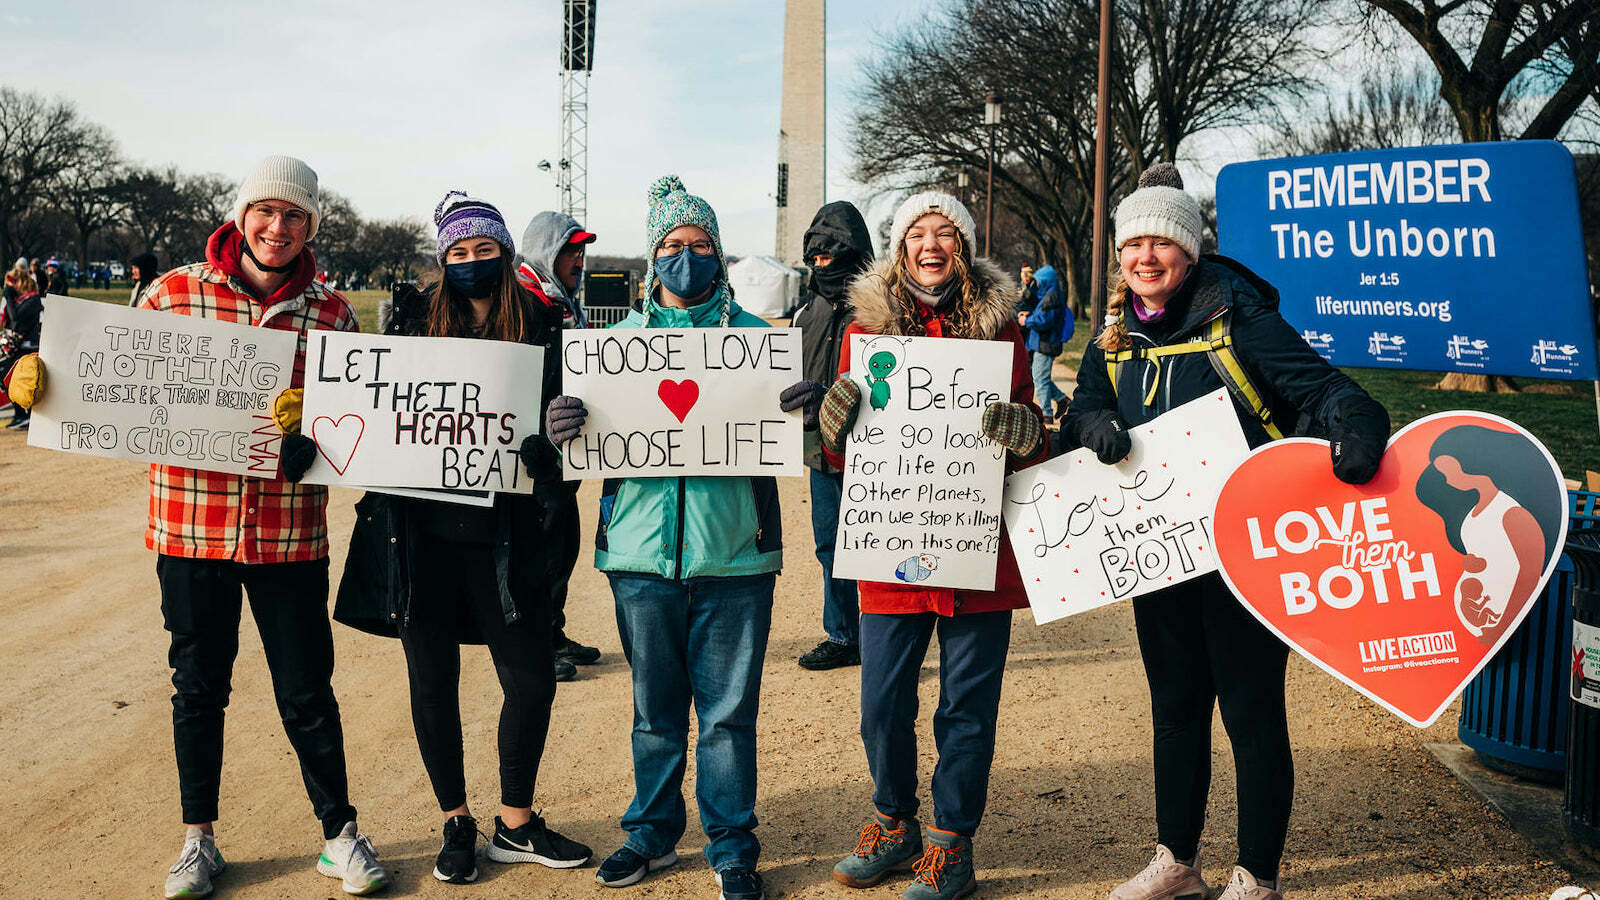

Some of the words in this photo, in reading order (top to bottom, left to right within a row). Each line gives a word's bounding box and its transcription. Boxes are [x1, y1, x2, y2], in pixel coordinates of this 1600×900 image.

[1267, 158, 1492, 211] REMEMBER
[1270, 222, 1334, 259] The
[1348, 219, 1496, 258] Unborn
[1359, 272, 1377, 286] Jer
[1379, 272, 1400, 286] 1:5
[1315, 295, 1452, 322] liferunners.org
[105, 325, 212, 356] THERE
[230, 338, 257, 360] is
[318, 335, 392, 383] LET
[564, 334, 686, 375] CHOOSE
[703, 332, 792, 371] LOVE
[78, 351, 281, 390] NOTHING
[81, 383, 162, 405] EASIER
[163, 384, 210, 405] THAN
[215, 389, 269, 410] BEING
[365, 381, 482, 413] THEIR
[907, 366, 1000, 411] Before
[150, 405, 169, 425] A
[395, 412, 517, 446] HEARTS
[60, 421, 118, 450] PRO
[126, 426, 249, 463] CHOICE
[247, 415, 282, 472] MAN
[568, 429, 685, 470] CHOOSE
[702, 419, 786, 467] LIFE
[900, 423, 933, 449] go
[442, 446, 521, 489] BEAT
[849, 453, 888, 475] for
[897, 454, 935, 476] life
[947, 461, 975, 477] on
[848, 481, 911, 502] Other
[918, 483, 986, 504] Planets,
[844, 508, 883, 526] Can
[1010, 470, 1175, 558] Love
[1104, 514, 1167, 546] them
[1246, 497, 1393, 560] LOVE
[843, 530, 880, 550] Life
[920, 532, 953, 550] this
[1313, 531, 1416, 569] them
[1279, 552, 1442, 616] BOTH
[1358, 638, 1399, 663] LIVE
[1400, 632, 1455, 656] ACTION
[1403, 656, 1459, 668] @liveactionorg
